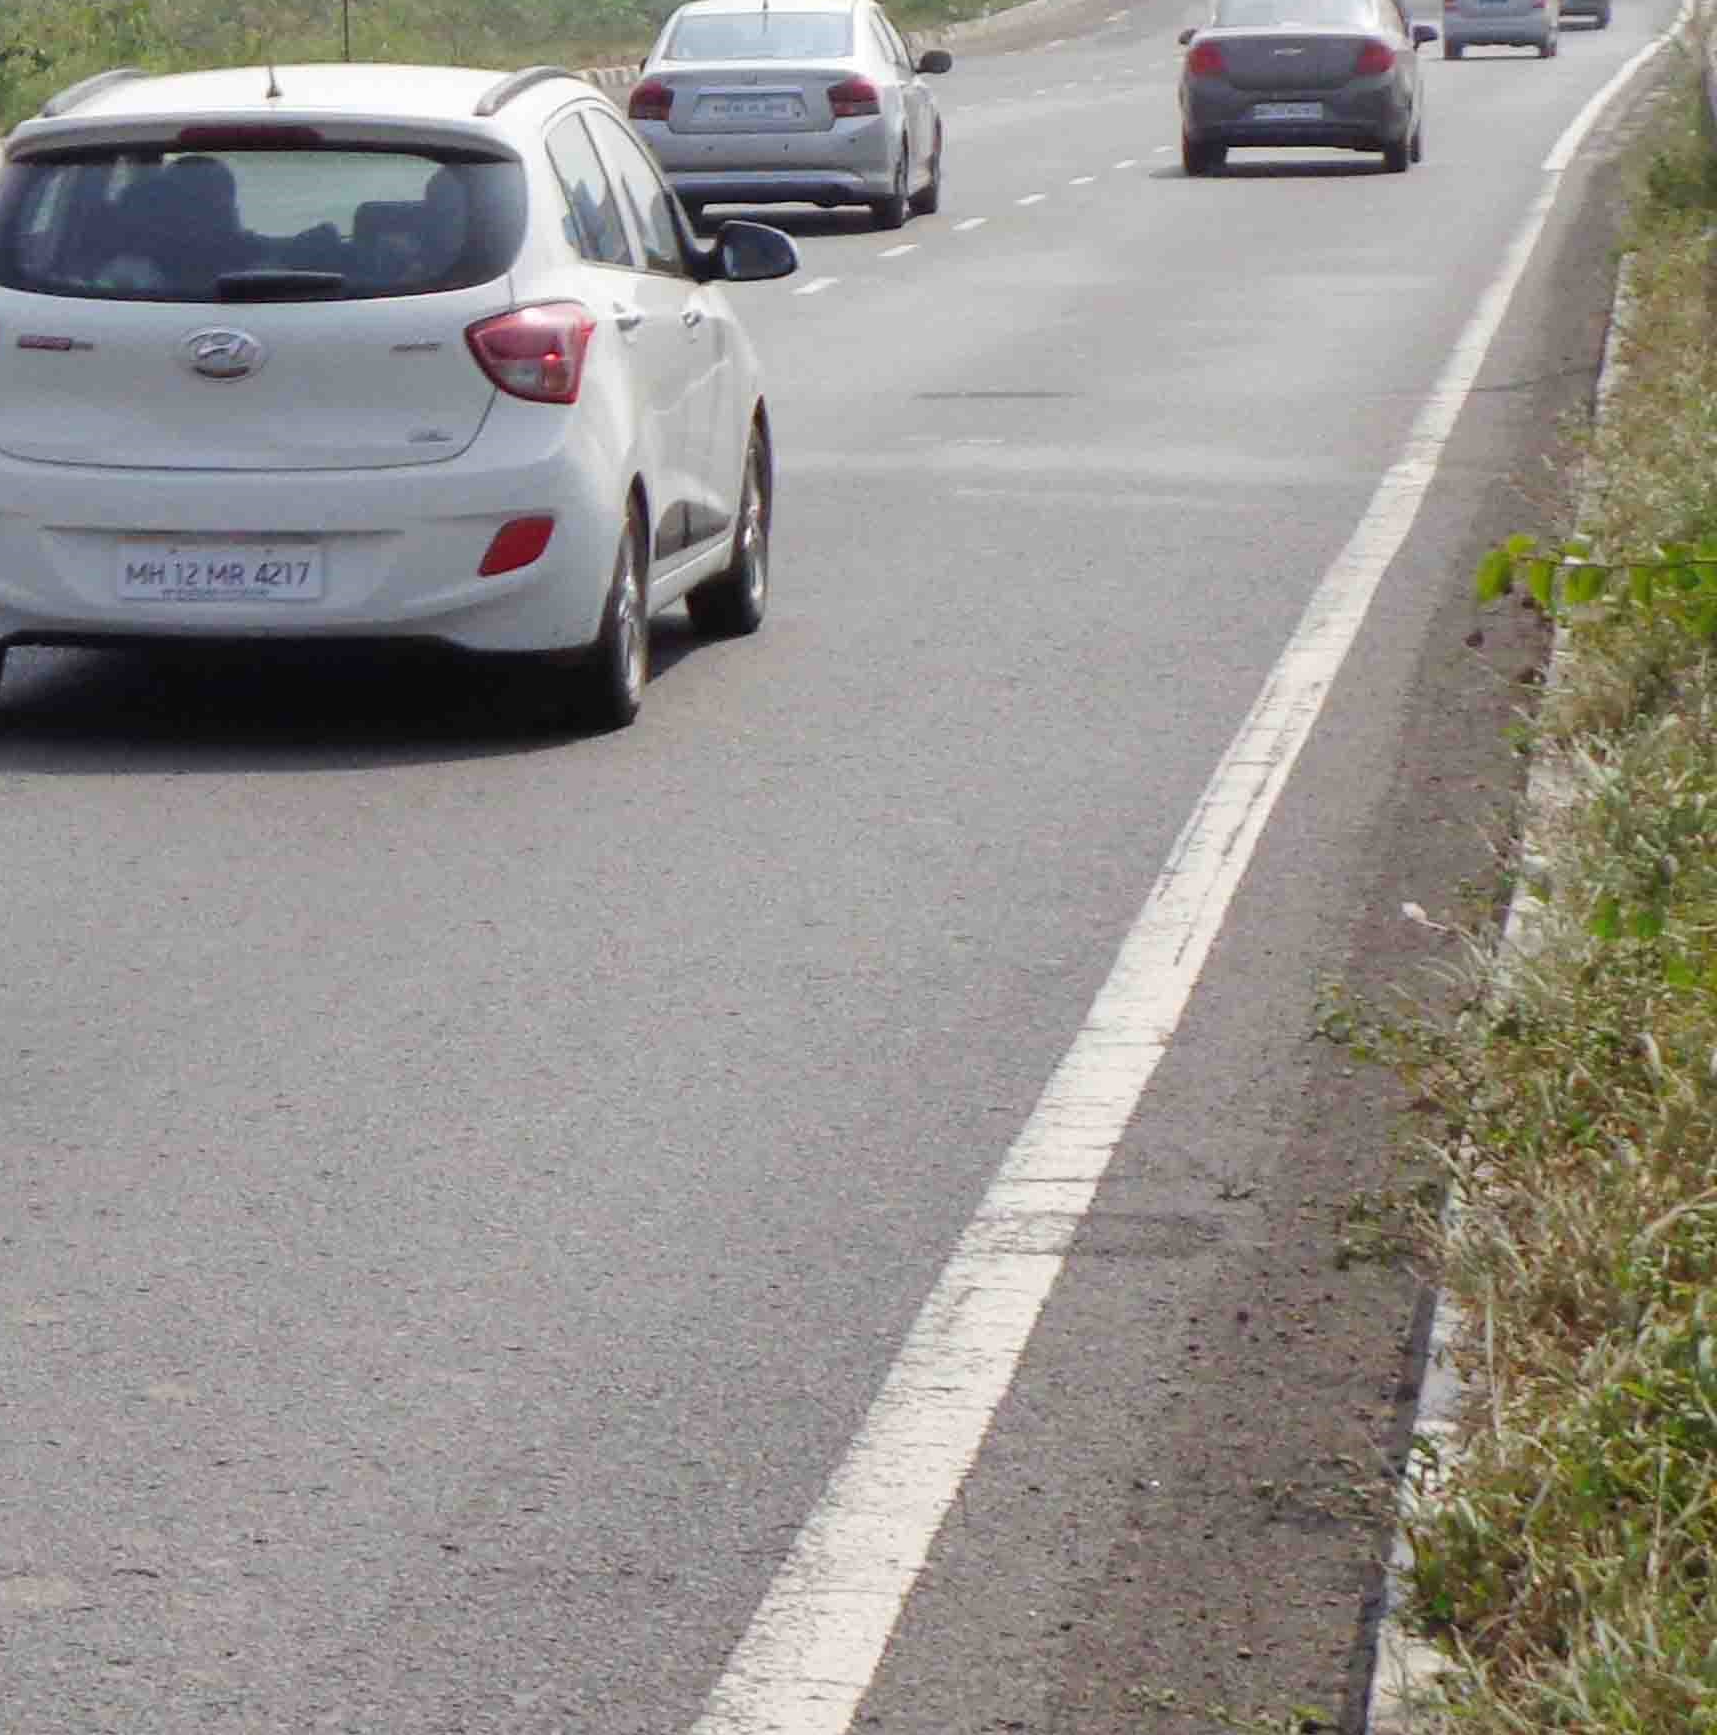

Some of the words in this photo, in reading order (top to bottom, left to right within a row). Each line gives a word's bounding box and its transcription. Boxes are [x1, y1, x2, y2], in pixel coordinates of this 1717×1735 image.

[125, 563, 165, 585] MH
[174, 562, 199, 585] 12
[207, 562, 246, 585] MR
[253, 561, 312, 586] 4217
